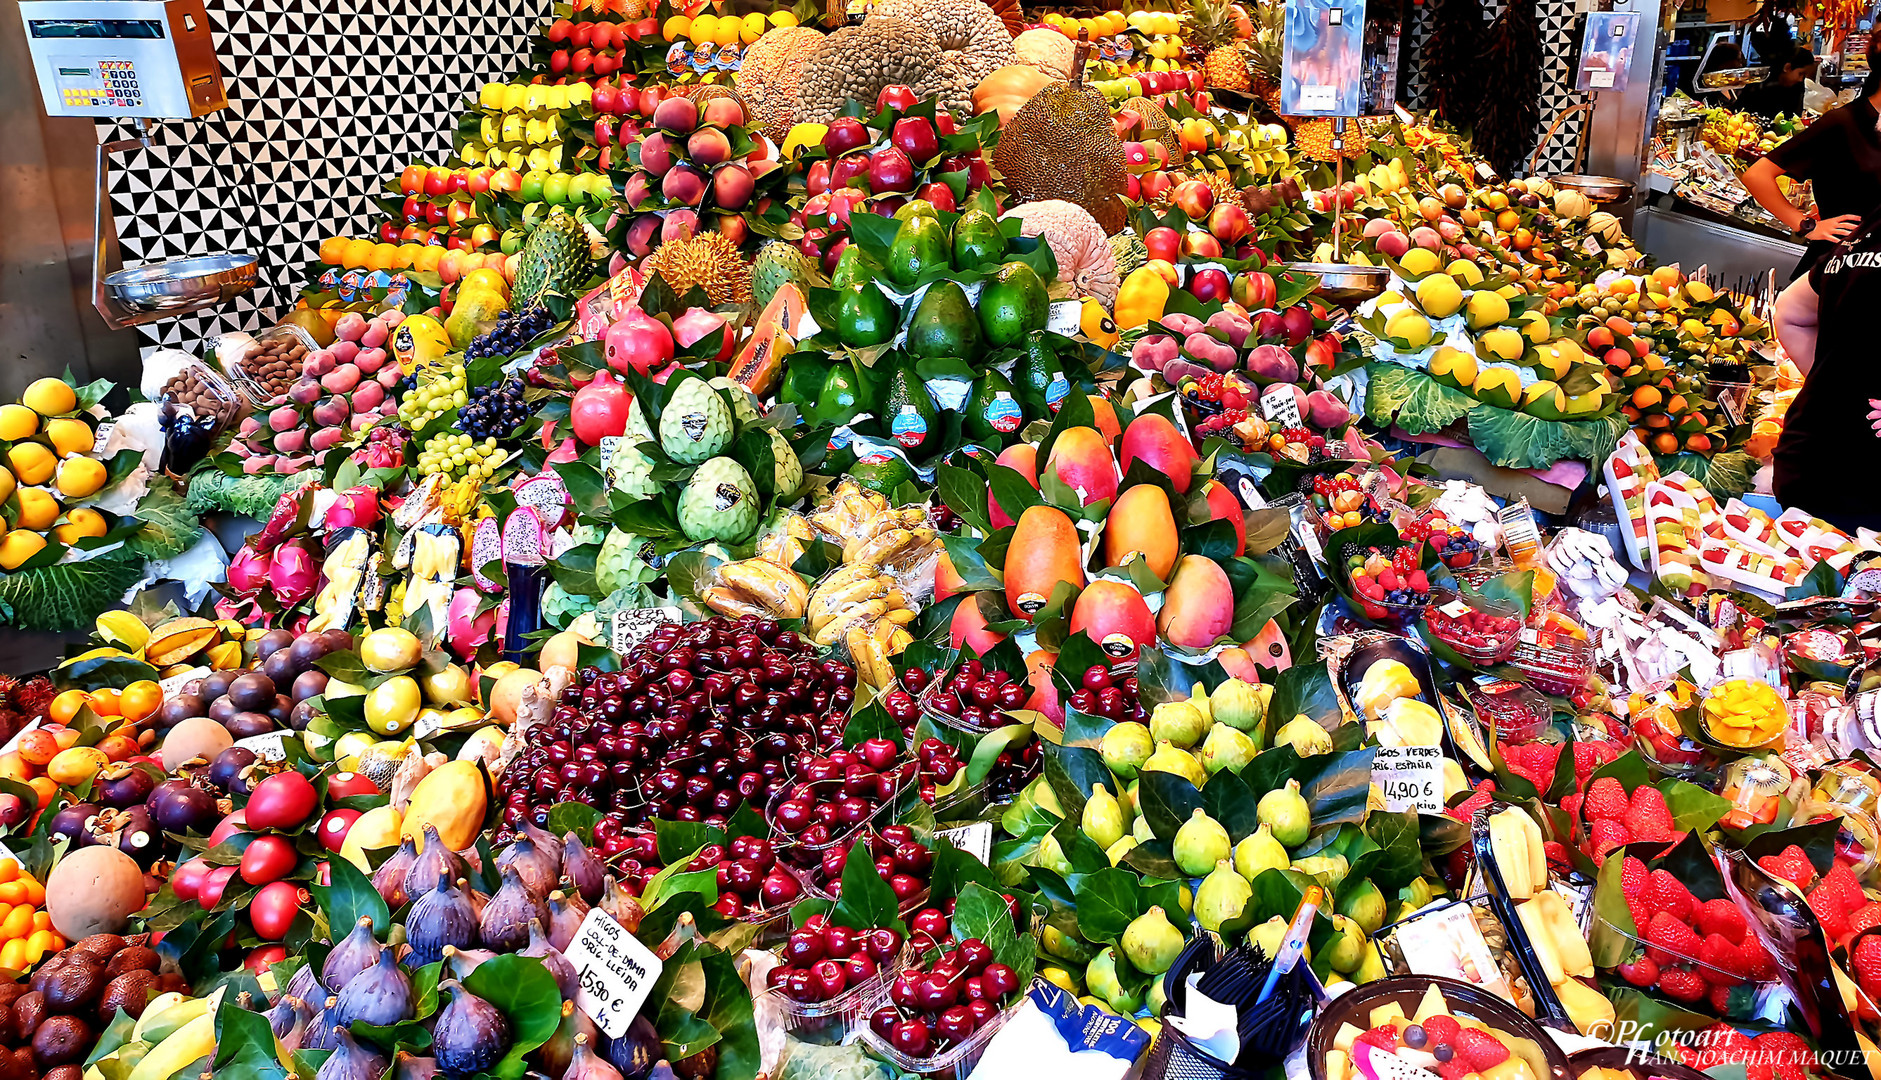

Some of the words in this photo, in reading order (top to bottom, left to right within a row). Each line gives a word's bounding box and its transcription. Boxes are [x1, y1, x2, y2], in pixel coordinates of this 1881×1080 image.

[1406, 747, 1440, 758] VERDES
[1395, 760, 1433, 770] ESPAÑA
[1383, 780, 1419, 801] 14,90
[578, 963, 610, 1001] 15,90
[611, 998, 624, 1013] €
[1105, 1019, 1121, 1035] 100
